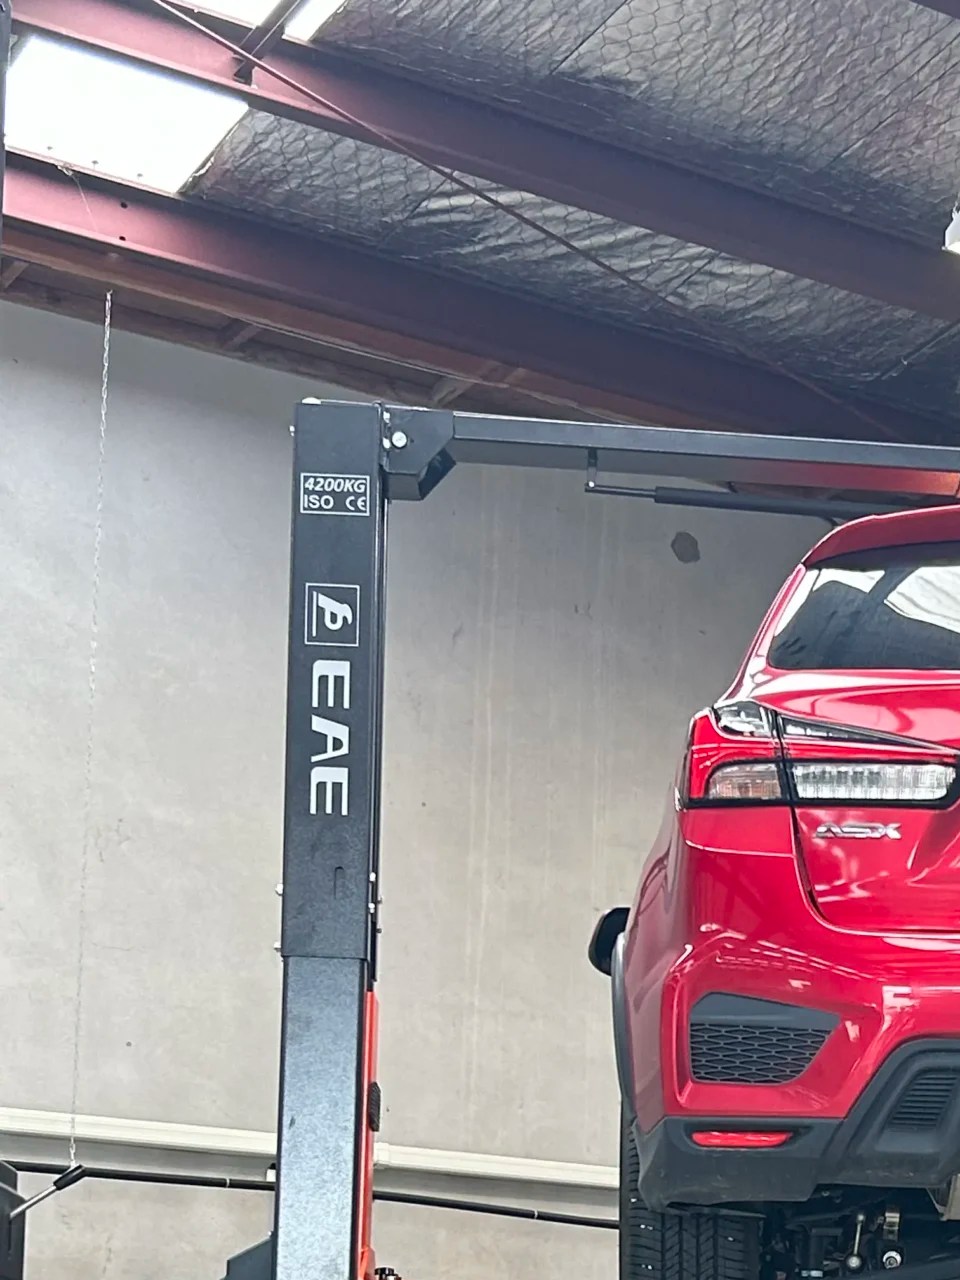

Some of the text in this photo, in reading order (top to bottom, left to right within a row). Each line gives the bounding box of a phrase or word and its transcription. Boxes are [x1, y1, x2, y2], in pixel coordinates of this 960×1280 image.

[304, 477, 367, 493] 4200KG
[304, 494, 335, 510] ISO
[310, 659, 351, 816] EAE
[815, 822, 902, 840] ASX
